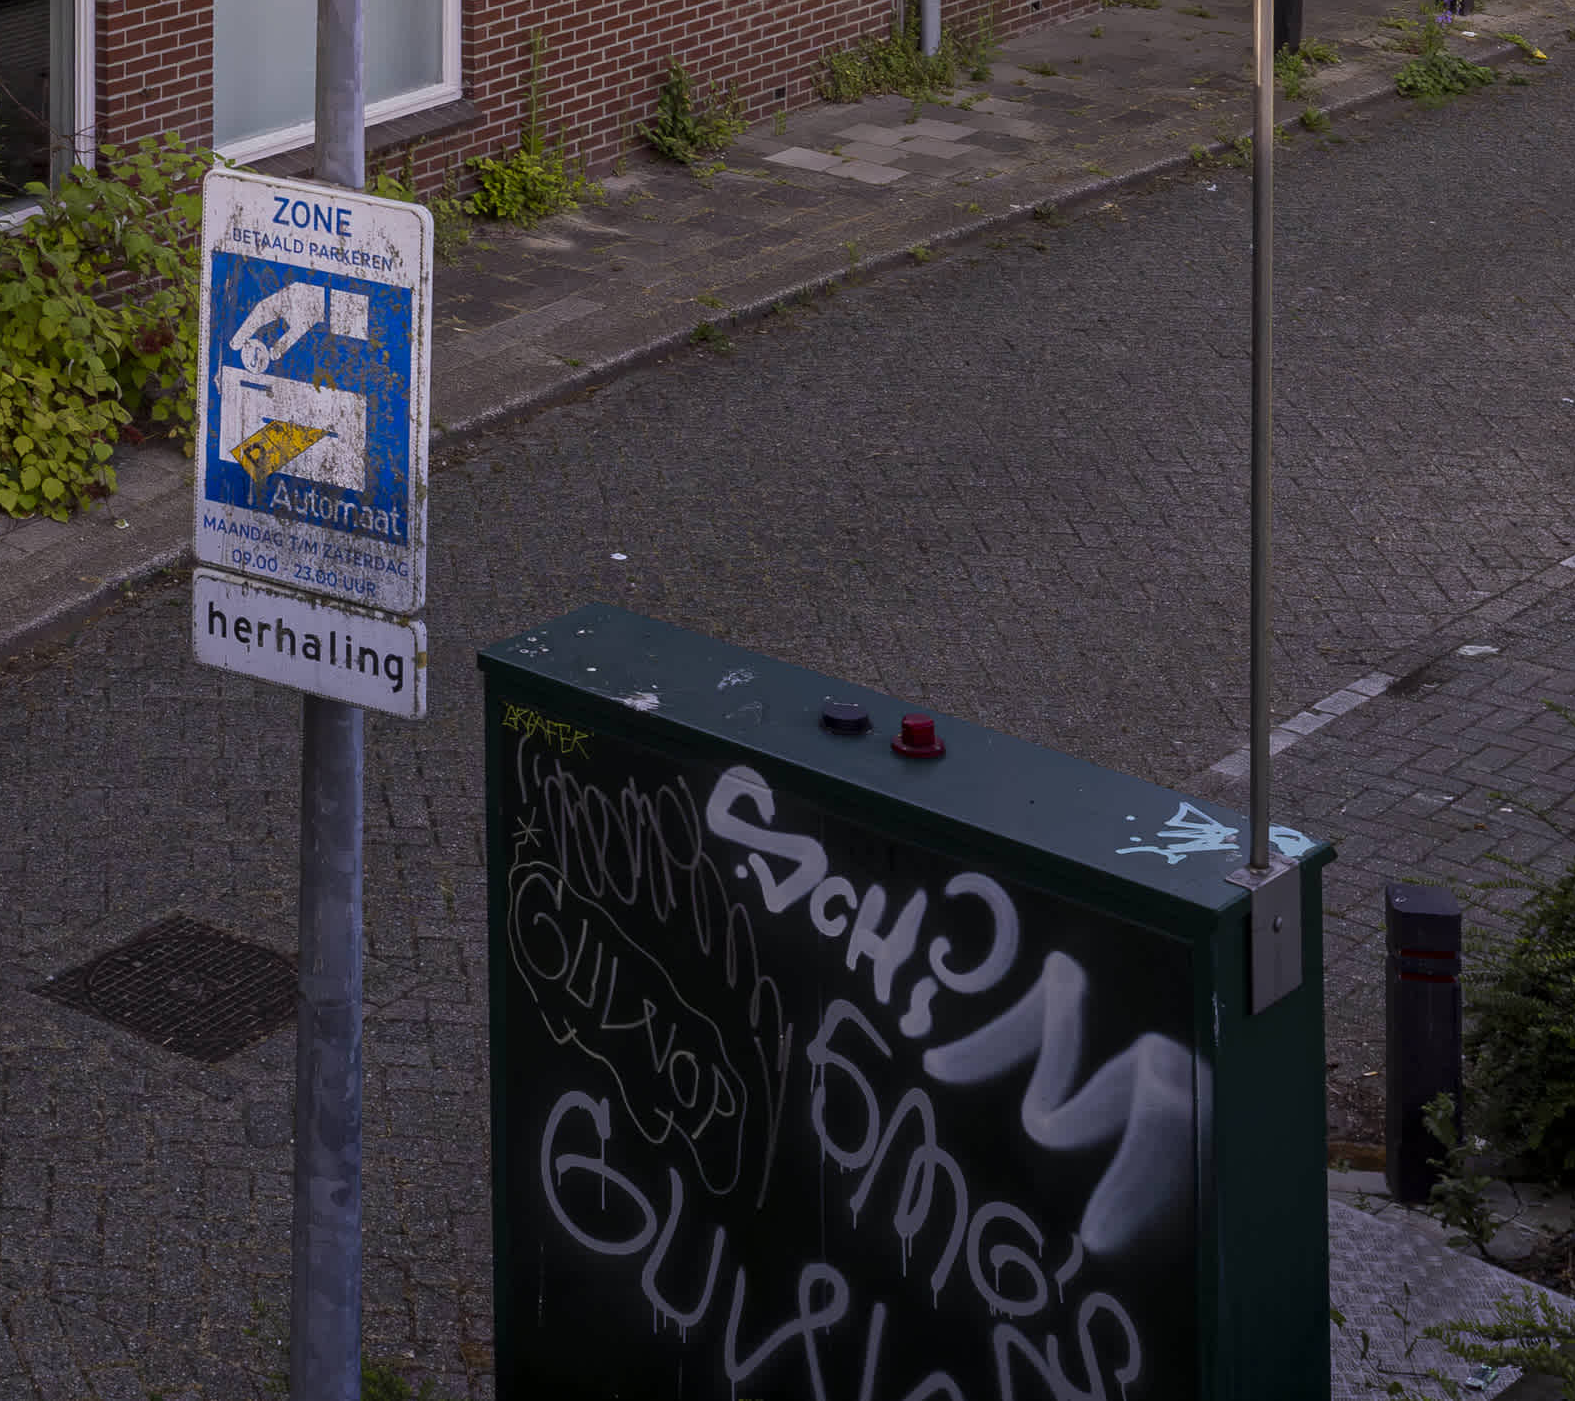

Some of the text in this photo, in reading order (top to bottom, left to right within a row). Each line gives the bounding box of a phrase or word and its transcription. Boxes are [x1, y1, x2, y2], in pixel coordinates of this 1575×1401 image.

[272, 196, 352, 237] ZONE
[233, 227, 393, 272] BETAALD PARKEREN
[270, 479, 402, 536] Automaat
[203, 515, 409, 577] MAANDAG T/M ZATERDAG
[232, 549, 278, 572] 09.00
[294, 563, 337, 587] 23.00
[342, 575, 376, 596] UUR
[208, 601, 404, 693] herhaling
